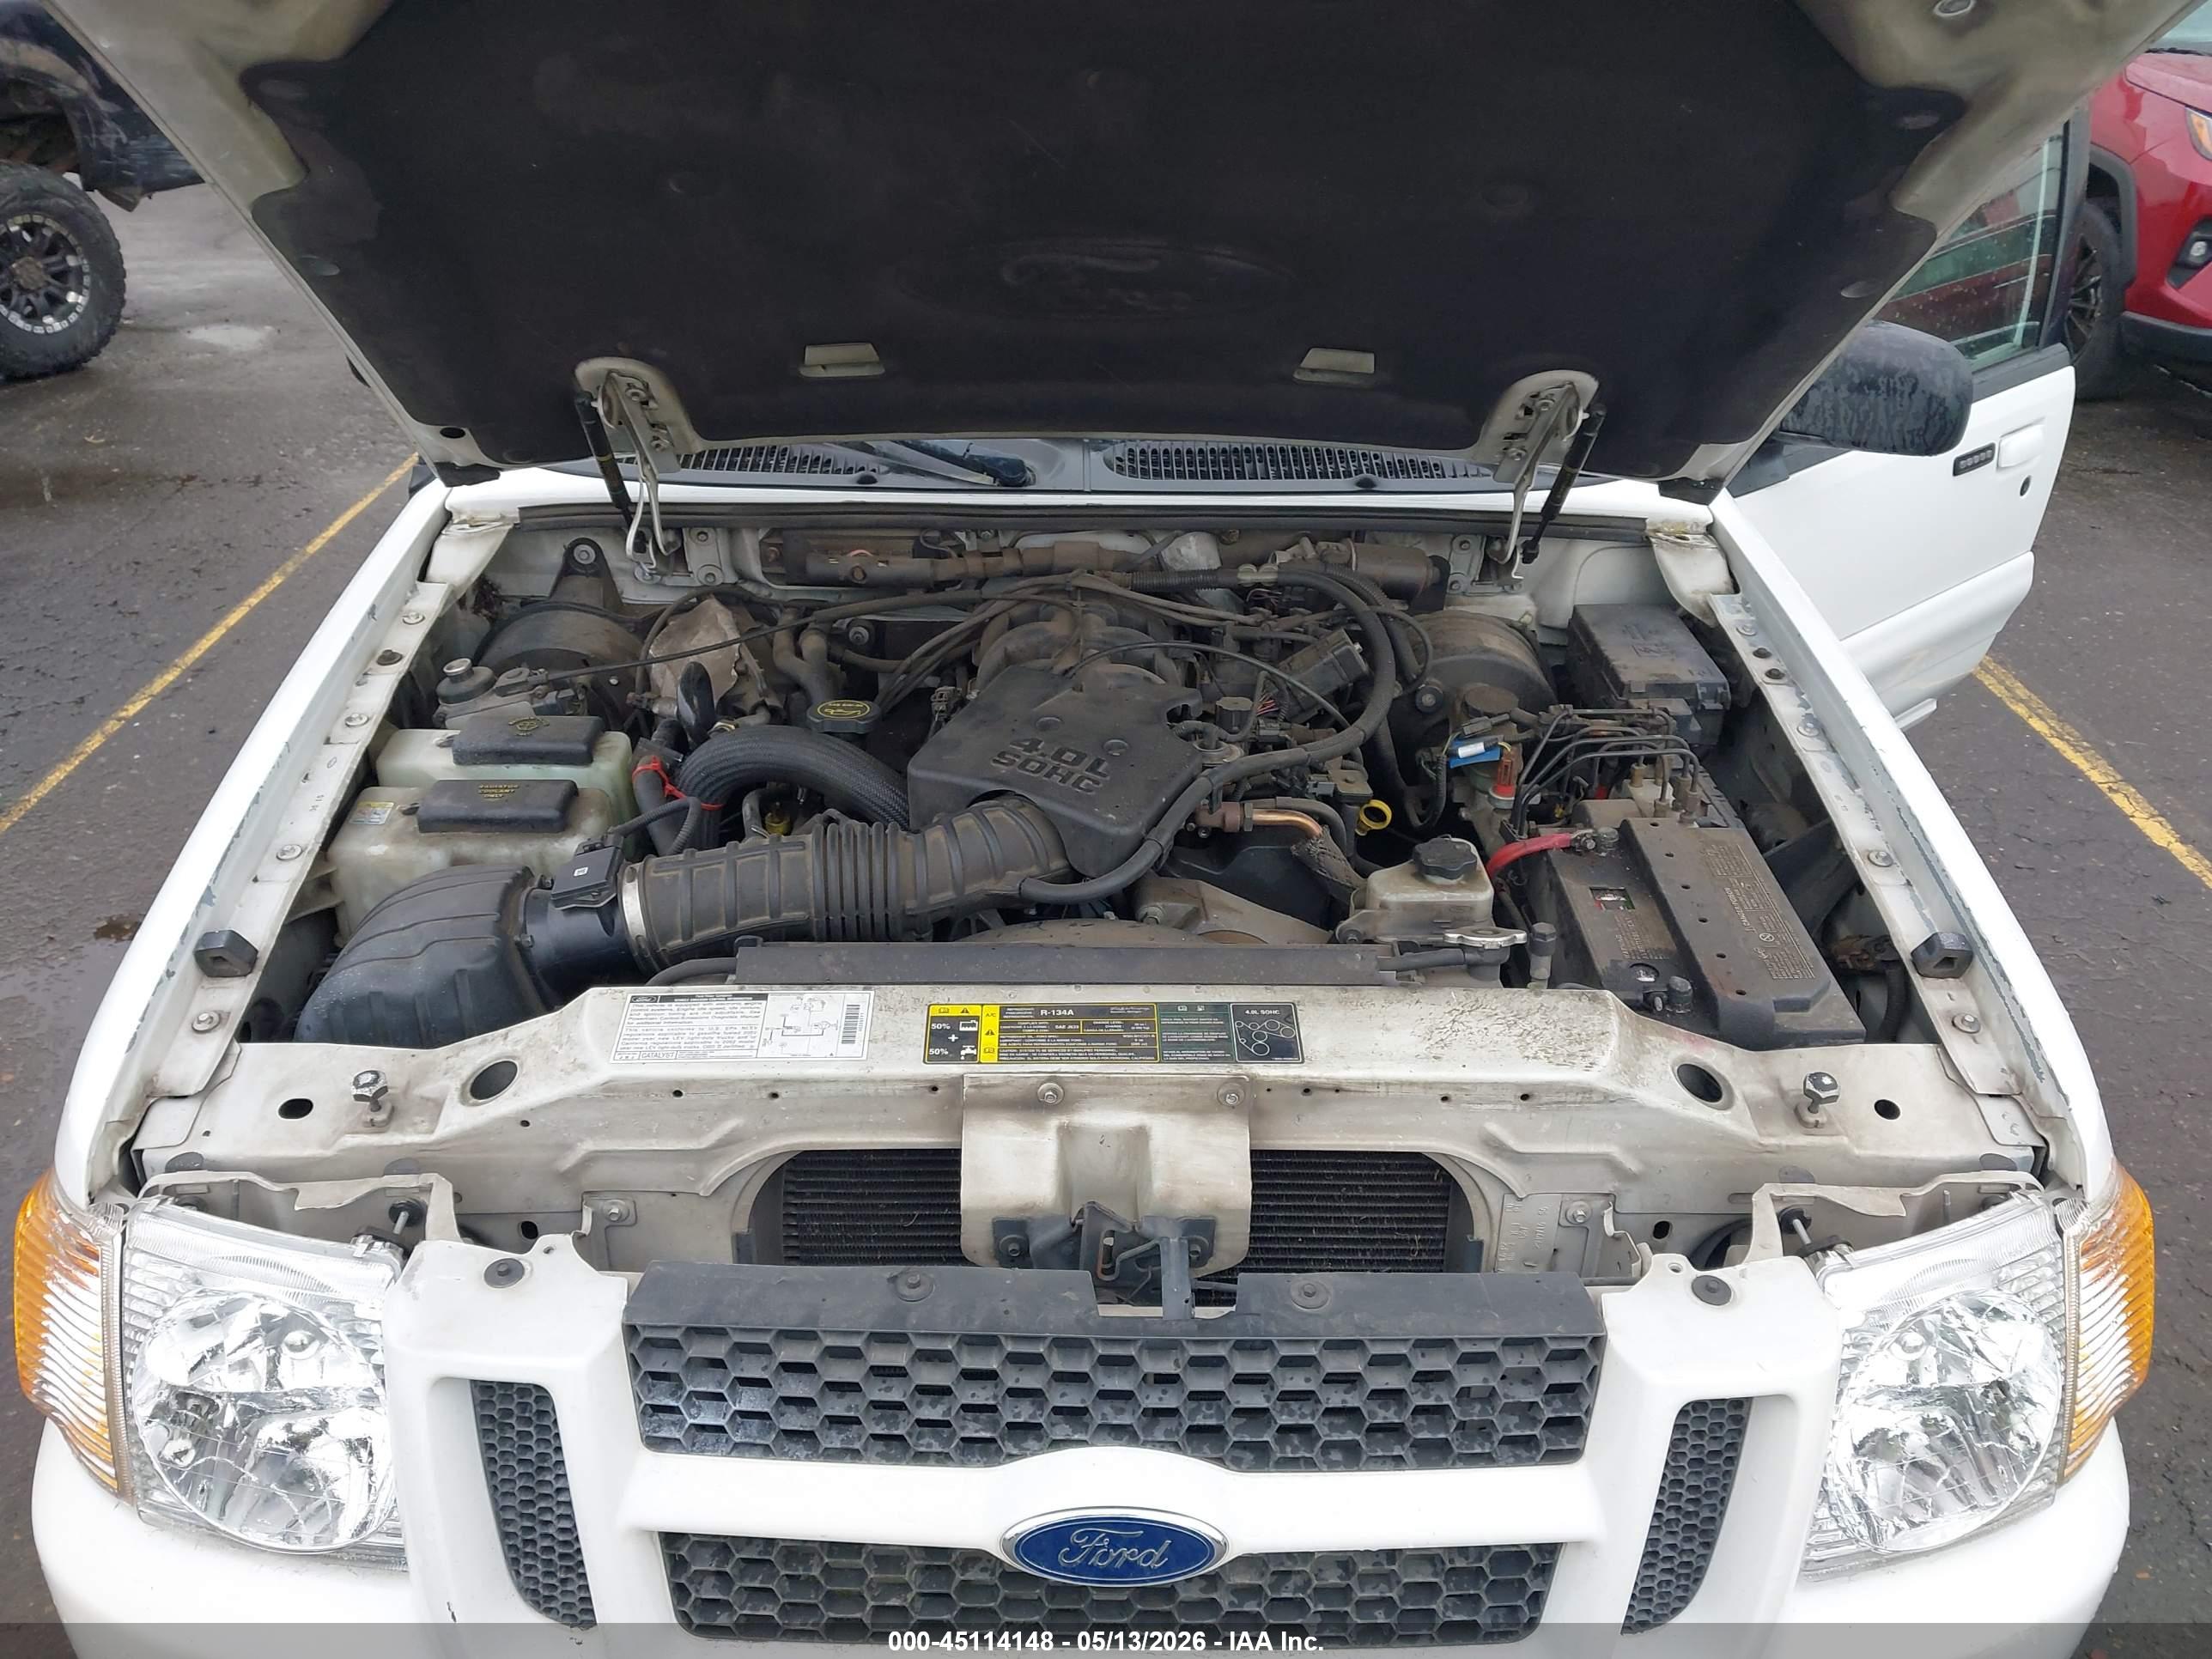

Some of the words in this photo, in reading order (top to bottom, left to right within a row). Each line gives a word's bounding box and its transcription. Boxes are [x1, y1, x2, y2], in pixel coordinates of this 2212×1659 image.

[991, 751, 1103, 795] SOHC
[1009, 738, 1109, 780] 4.0L
[1057, 1528, 1172, 1570] Ford
